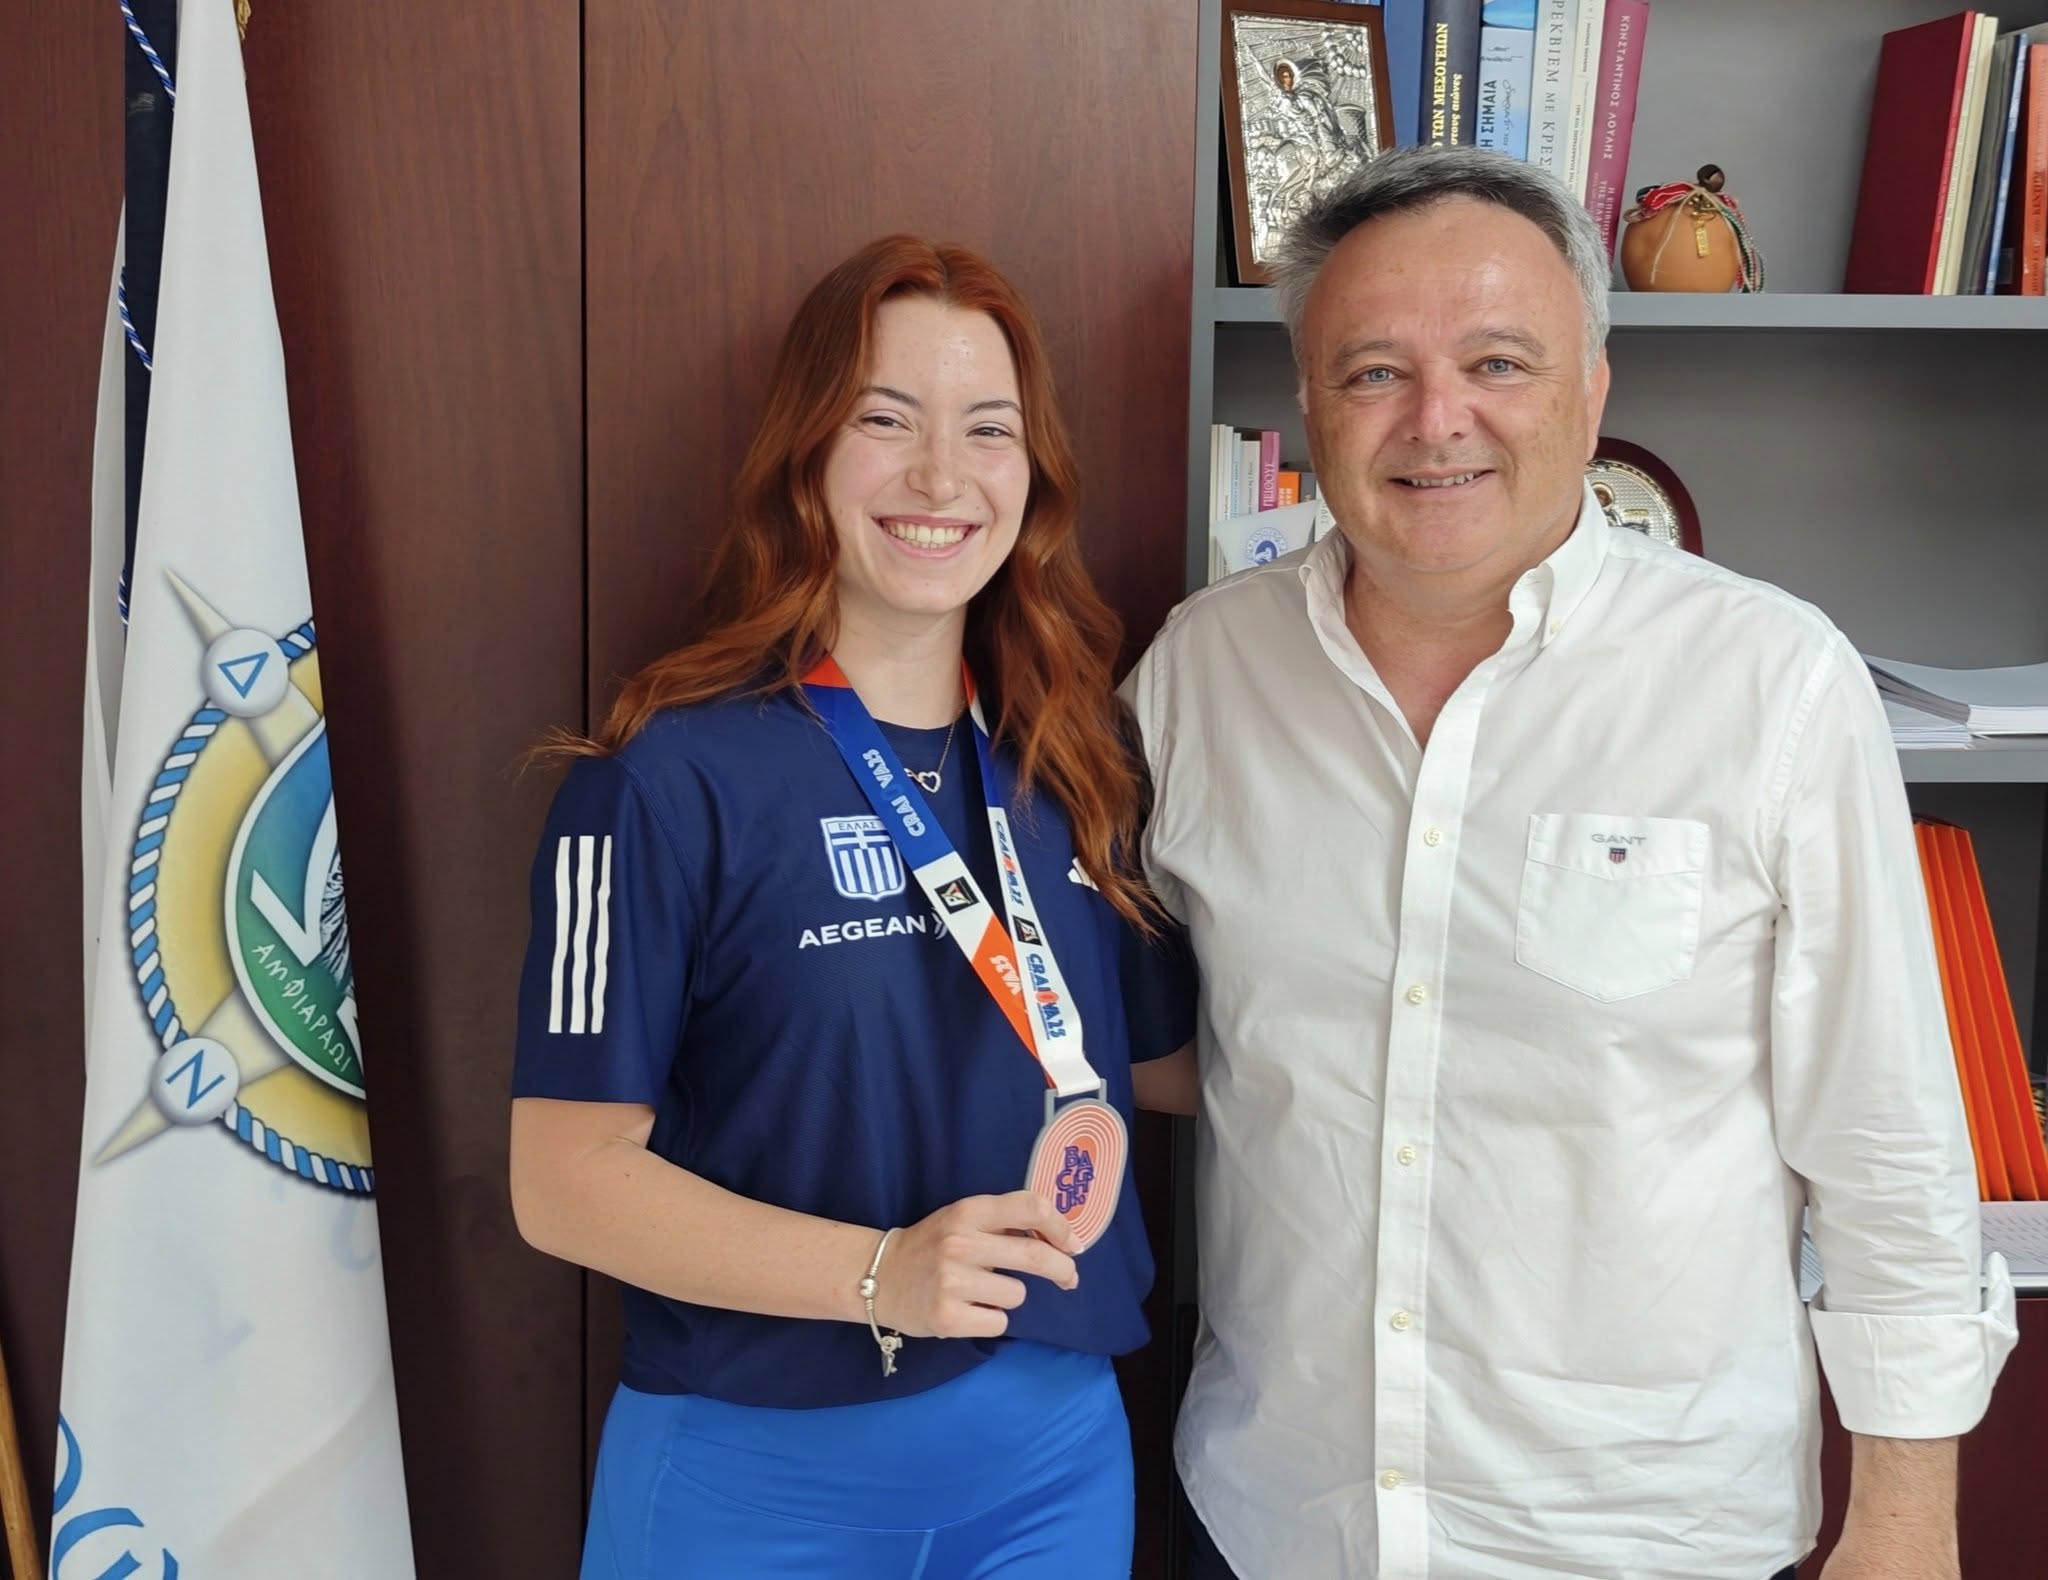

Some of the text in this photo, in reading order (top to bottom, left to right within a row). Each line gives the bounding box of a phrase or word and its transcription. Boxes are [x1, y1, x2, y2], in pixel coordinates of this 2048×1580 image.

[1545, 0, 1565, 82] ΡΕΚΒΙΕΜ
[1433, 23, 1448, 105] ΜΕΣΟΓΕΙΩΝ
[1544, 92, 1556, 112] ΜΕ
[1603, 16, 1630, 159] ΚΩΝΣΤΑΝΤΙΝΟΣ ΛΟΥΛΗΣ
[1432, 109, 1445, 138] ΤΩΝ
[1481, 80, 1497, 133] ΣΗΜΑΙΑ
[838, 821, 878, 832] ΕΛΛΑΣ
[1591, 833, 1647, 846] GANT
[798, 914, 926, 949] AEGEAN
